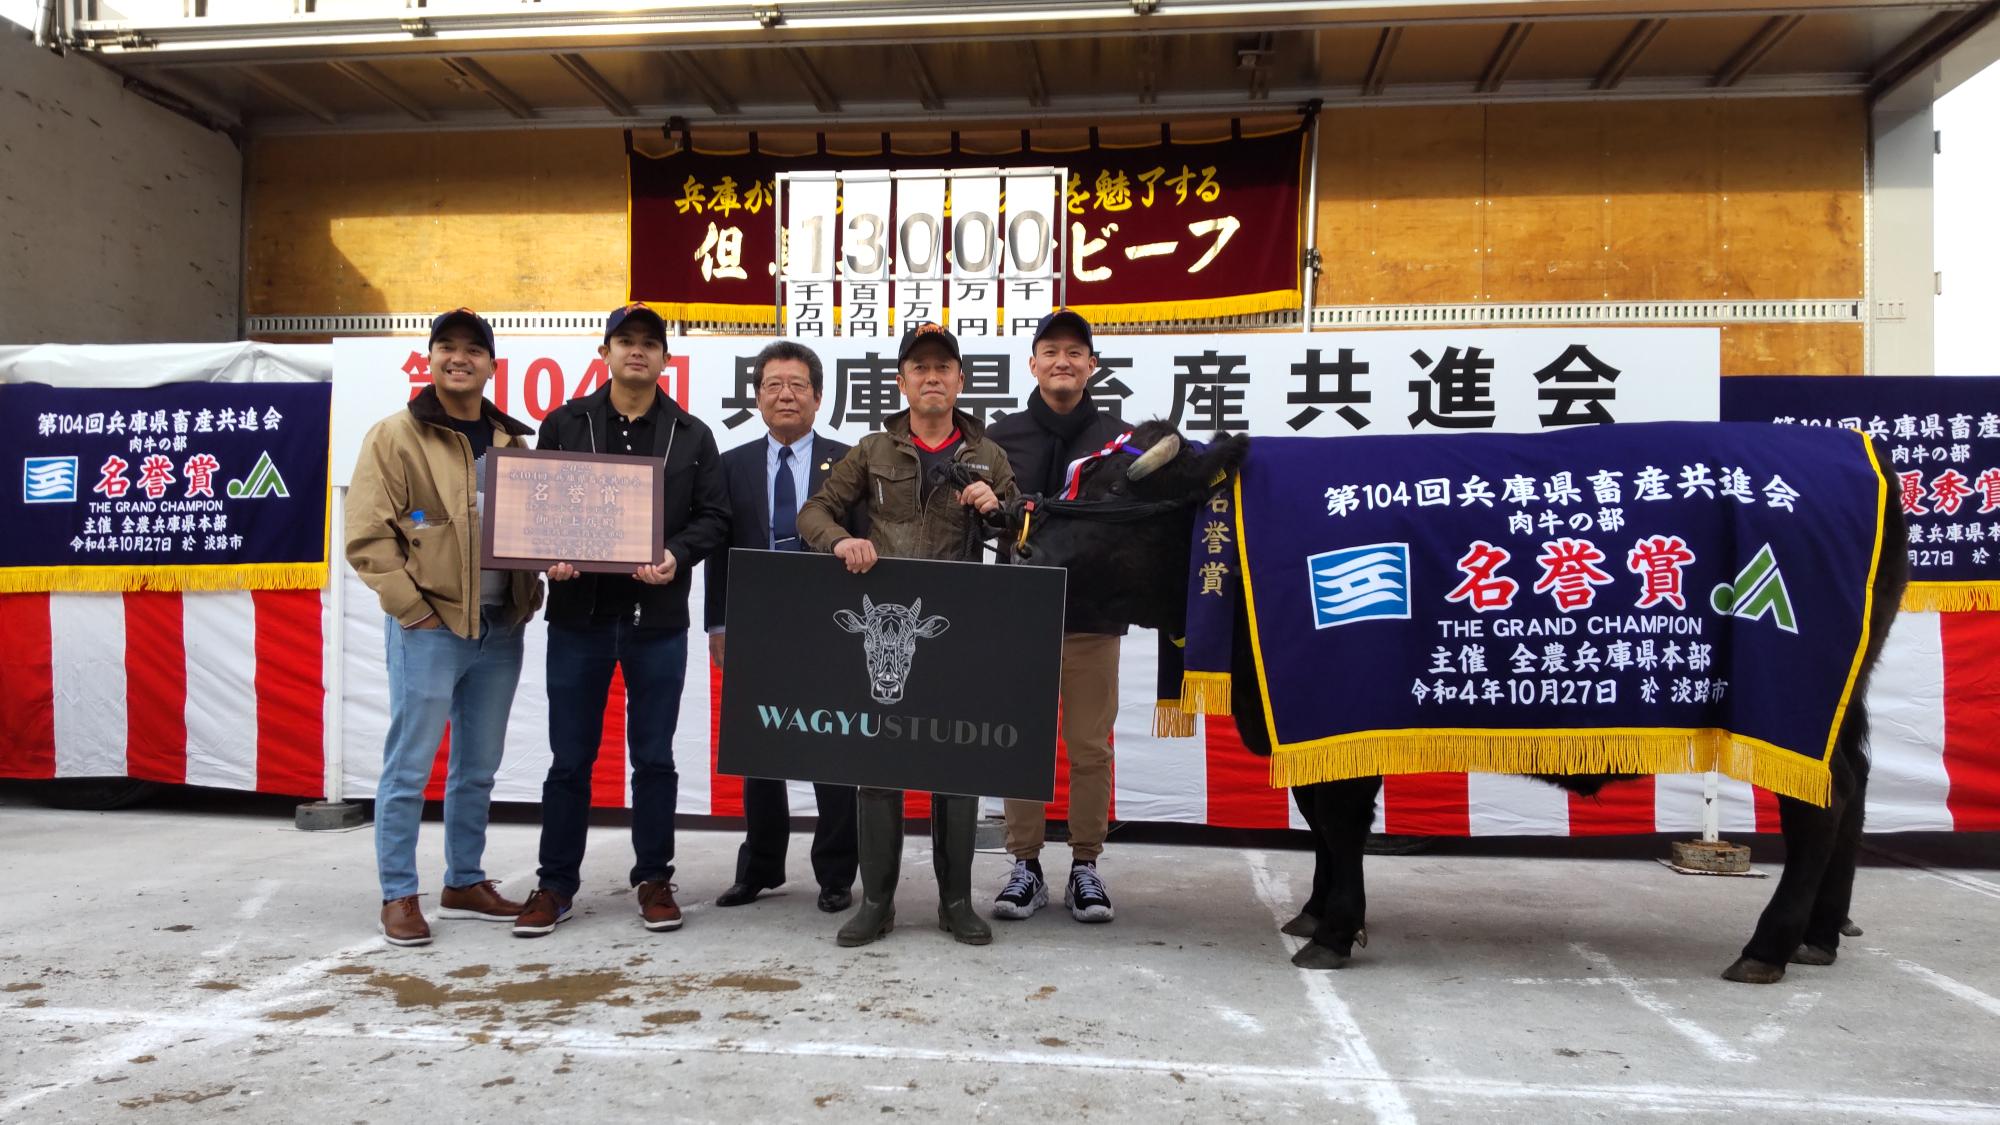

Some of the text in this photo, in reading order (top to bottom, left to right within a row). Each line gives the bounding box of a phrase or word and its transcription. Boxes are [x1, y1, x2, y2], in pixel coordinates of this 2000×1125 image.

[694, 216, 1240, 282] 但 ビーフ
[795, 284, 823, 337] 千万円
[850, 284, 879, 337] 百万円
[38, 406, 282, 436] 第104回兵庫県畜産共進会
[129, 435, 187, 453] 肉牛の部
[1891, 444, 1970, 464] 肉牛の部
[93, 454, 220, 499] 名誉賞
[1324, 463, 1800, 516] 第104回兵庫県畜産共進会
[89, 500, 223, 513] THE GRAND CHAMPION
[531, 482, 620, 505] 名誉賞
[84, 514, 227, 534] 主催 全農兵庫県本部
[1507, 506, 1625, 536] 肉牛の部
[70, 534, 243, 552] 令和4年10月27日 於 淡路市
[1972, 547, 1990, 564] 於
[1444, 534, 1697, 614] 名誉賞
[1438, 615, 1702, 638] THE GRAND CHAMPION
[1428, 639, 1712, 674] 主催 全農兵庫県本部
[1410, 676, 1728, 706] 令和4年10月27日 於 淡路市
